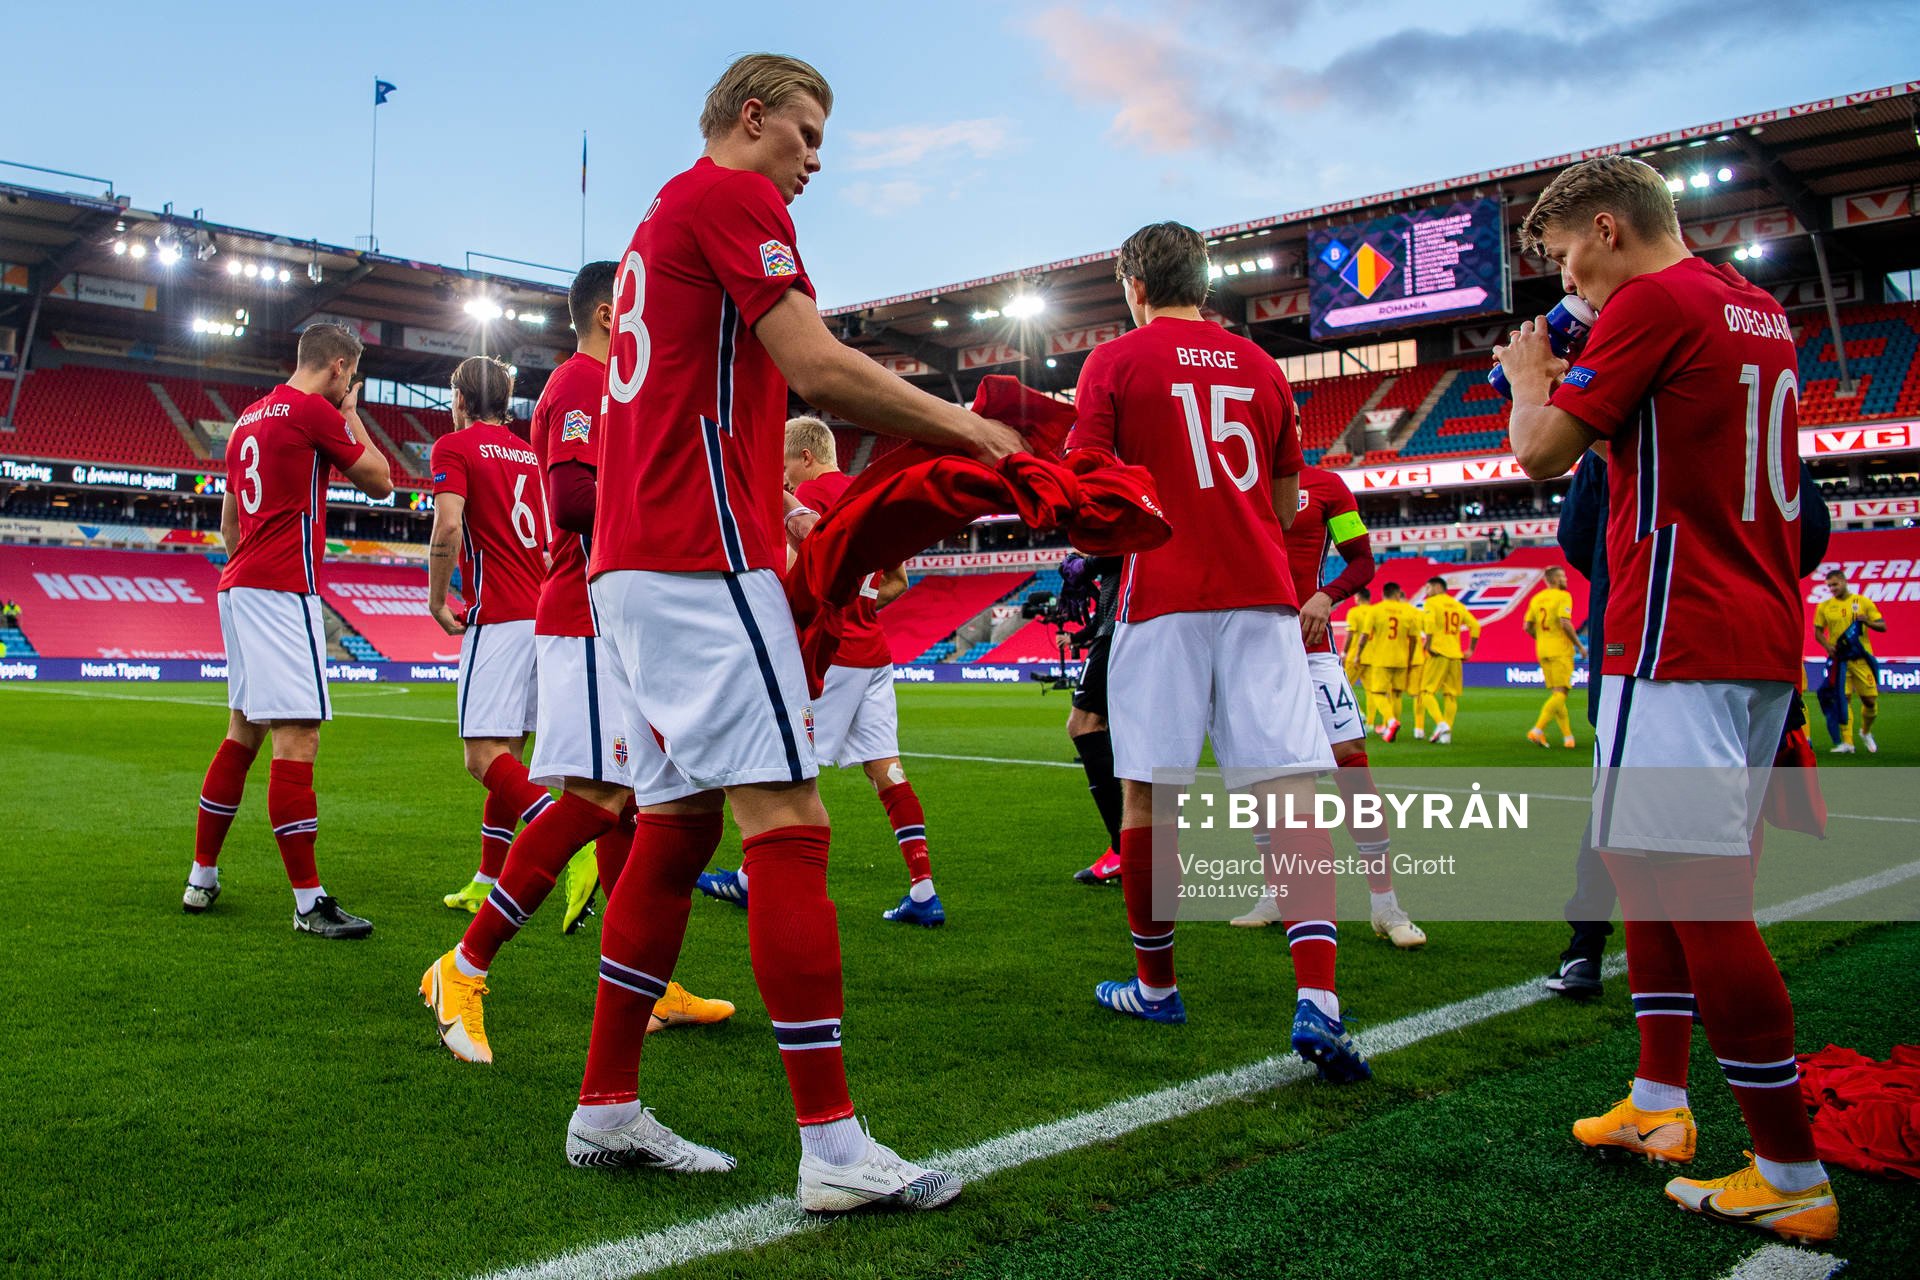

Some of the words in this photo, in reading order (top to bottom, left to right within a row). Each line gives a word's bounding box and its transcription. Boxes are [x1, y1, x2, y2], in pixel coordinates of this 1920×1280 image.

[1847, 87, 1892, 105] VG
[1790, 100, 1833, 117] VG
[1735, 111, 1776, 128] VG
[1682, 122, 1723, 139] VG
[1632, 133, 1670, 149] VG
[1685, 210, 1794, 247] VG
[1331, 248, 1340, 261] B
[1379, 301, 1428, 315] ROMANIA
[602, 251, 650, 414] 3
[1176, 347, 1238, 369] BERGE
[263, 404, 290, 419] AJER
[1171, 383, 1259, 492] 15
[1739, 364, 1800, 521] 10
[1816, 427, 1906, 452] VG
[479, 444, 538, 466] STRANDBE
[3, 461, 52, 482] Tipping
[241, 435, 262, 515] 3
[1367, 468, 1430, 488] VG
[512, 474, 538, 549] 6
[1856, 501, 1918, 516] VG
[1403, 528, 1446, 543] VG
[923, 557, 954, 568] VG
[998, 553, 1028, 564] VG
[33, 573, 205, 604] NORGE
[1388, 616, 1399, 640] 3
[1445, 611, 1460, 635] 19
[1540, 608, 1550, 631] 2
[81, 662, 117, 677] Norsk
[117, 662, 160, 680] Tipping
[341, 665, 377, 681] Tipping
[411, 666, 439, 678] Norsk
[905, 667, 935, 681] Tipping
[962, 667, 987, 679] Norsk
[987, 667, 1019, 681] Tipping
[1320, 681, 1353, 714] 14
